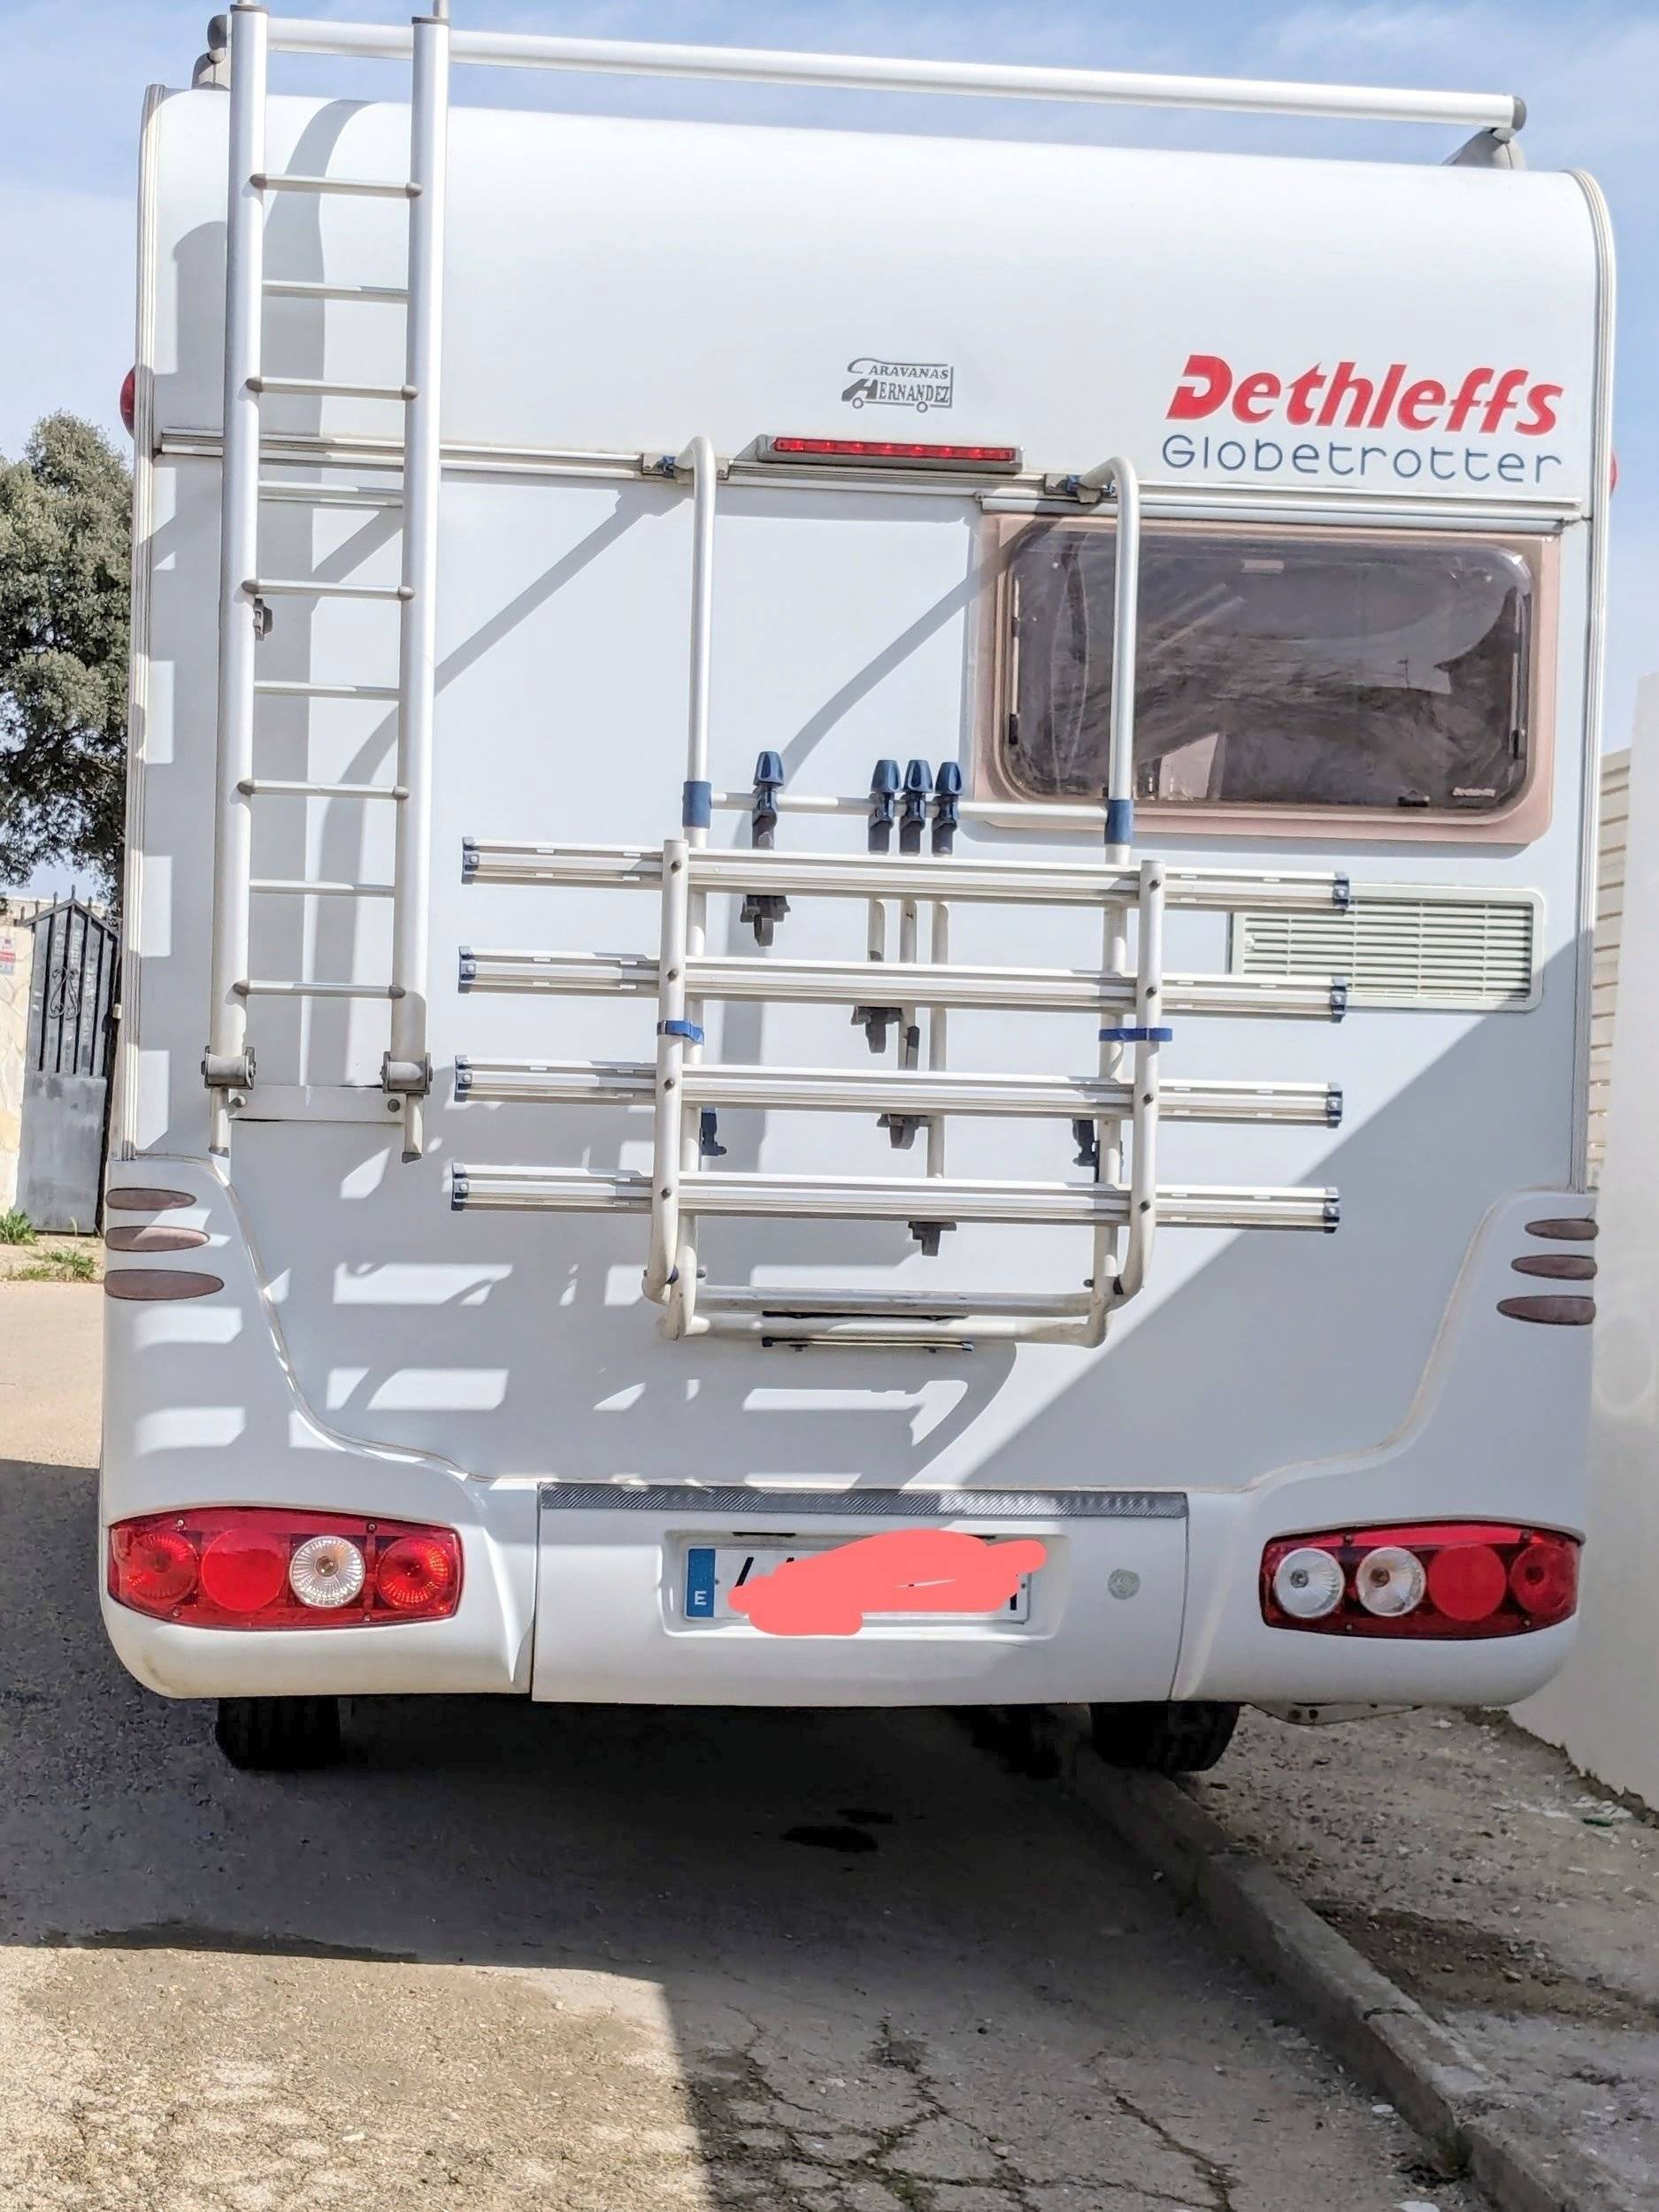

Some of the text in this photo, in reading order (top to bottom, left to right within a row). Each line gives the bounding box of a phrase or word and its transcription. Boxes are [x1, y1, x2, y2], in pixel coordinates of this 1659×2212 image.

[841, 378, 949, 403] HERNANDEZ
[1165, 354, 1564, 436] Dethleffs
[1162, 434, 1563, 484] Globetrotter
[695, 1590, 707, 1606] E
